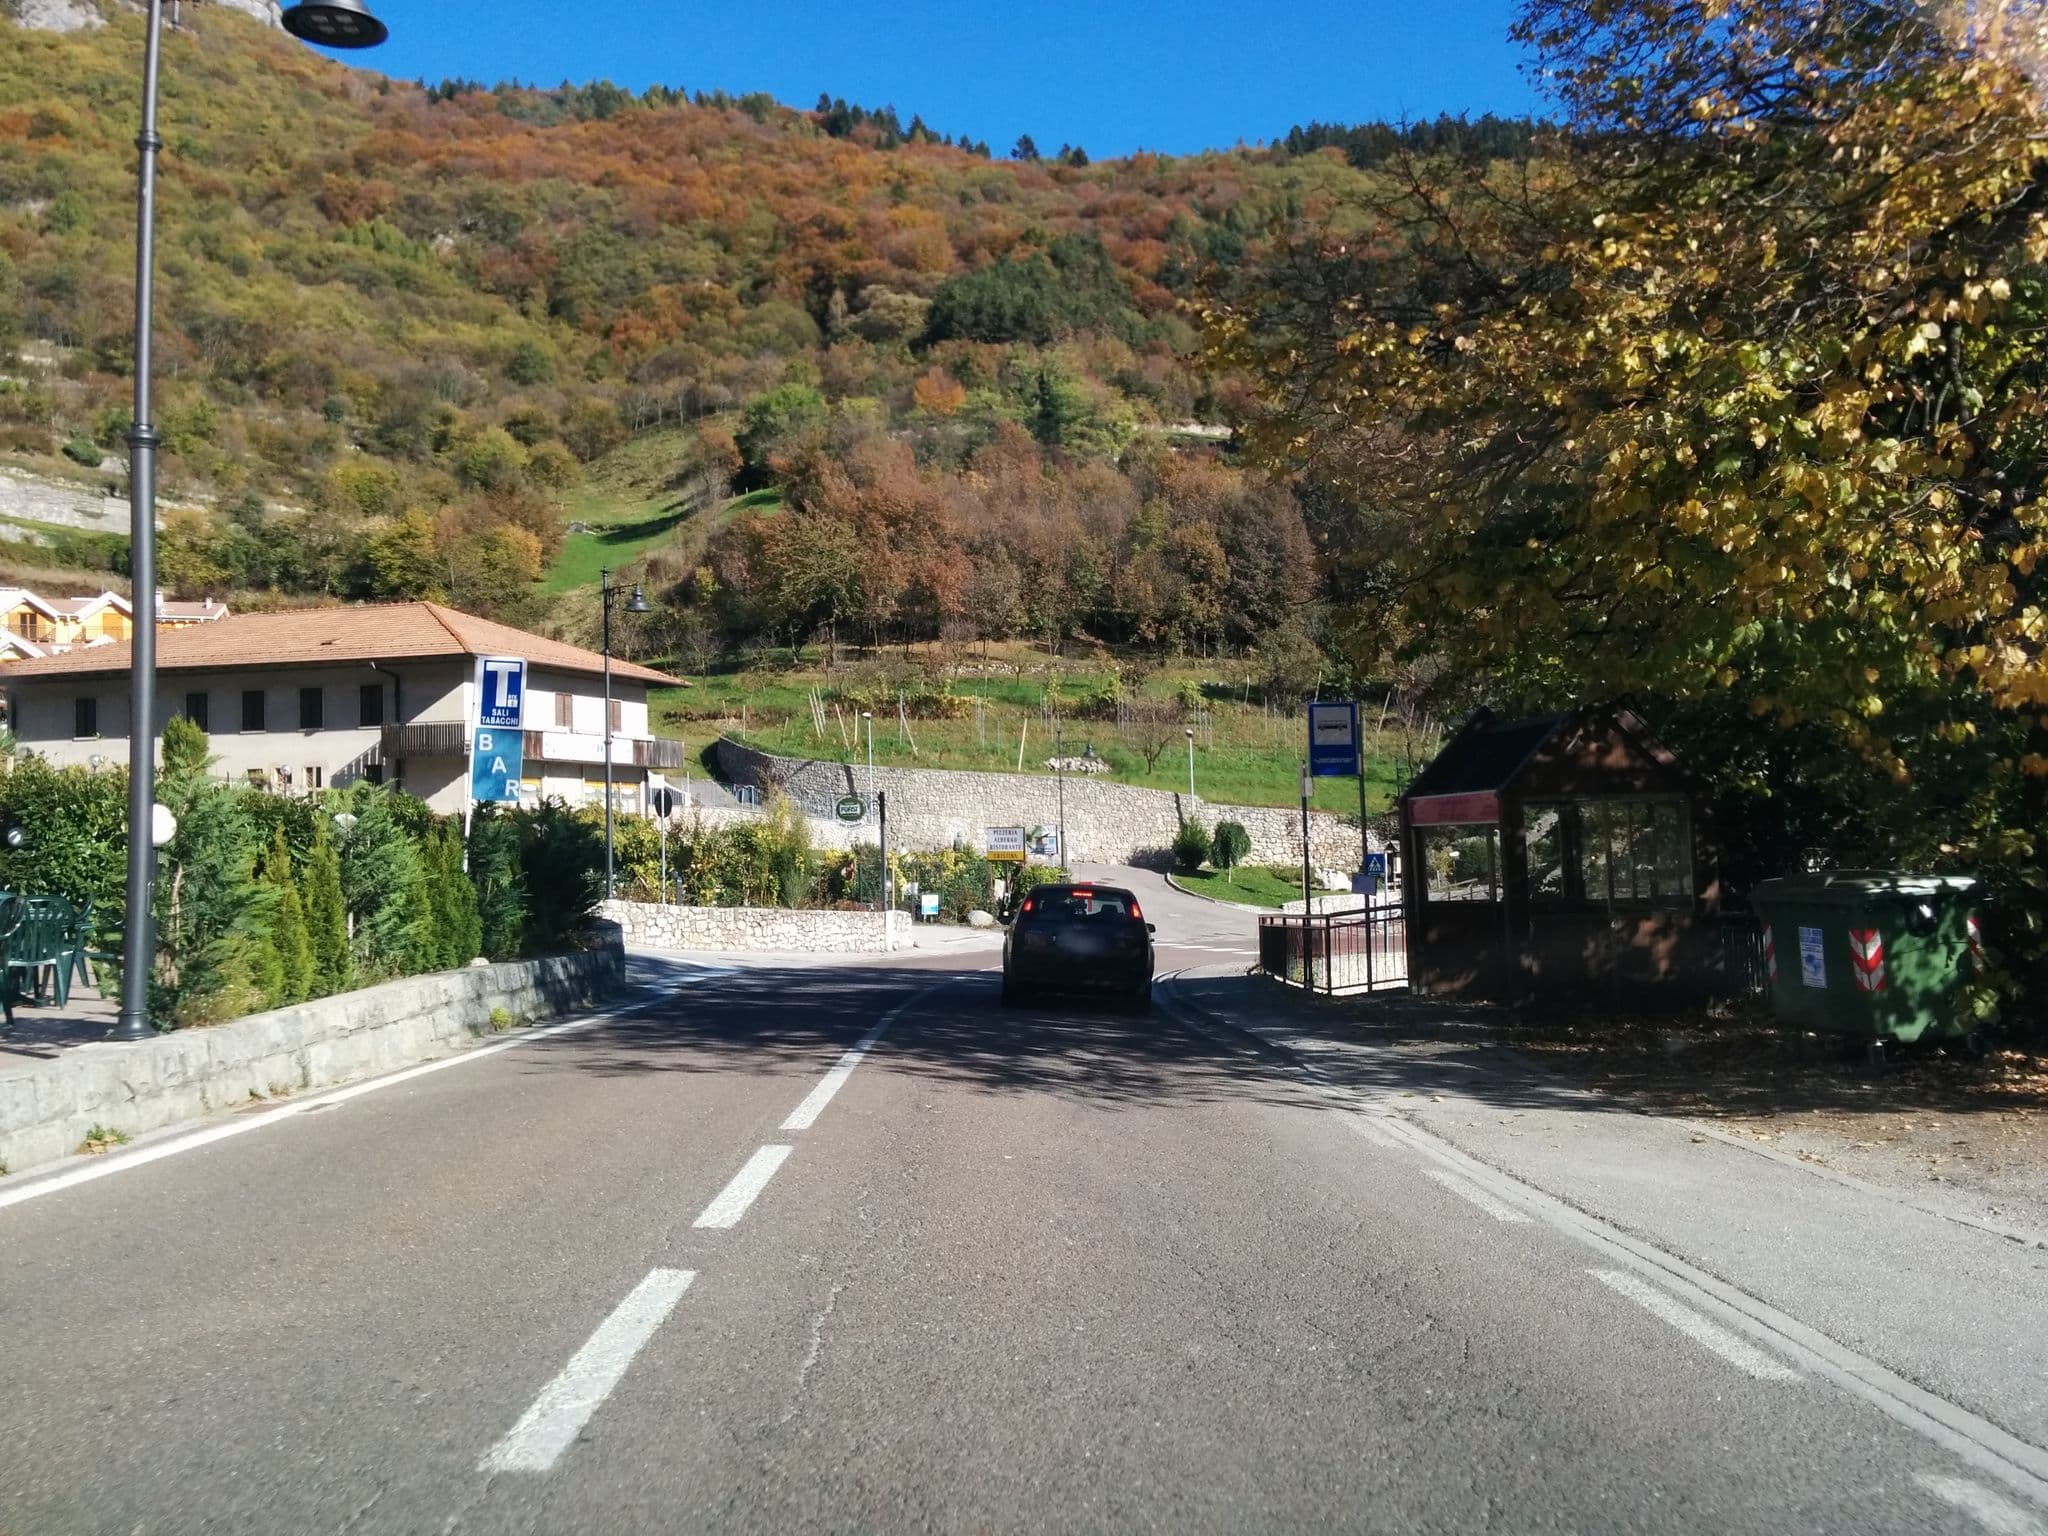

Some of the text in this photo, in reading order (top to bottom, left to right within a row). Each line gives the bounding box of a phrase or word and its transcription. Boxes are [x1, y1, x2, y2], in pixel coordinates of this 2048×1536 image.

[486, 662, 520, 707] T
[481, 716, 519, 725] TABACCHI
[491, 708, 509, 716] SALI
[479, 733, 519, 797] BAR
